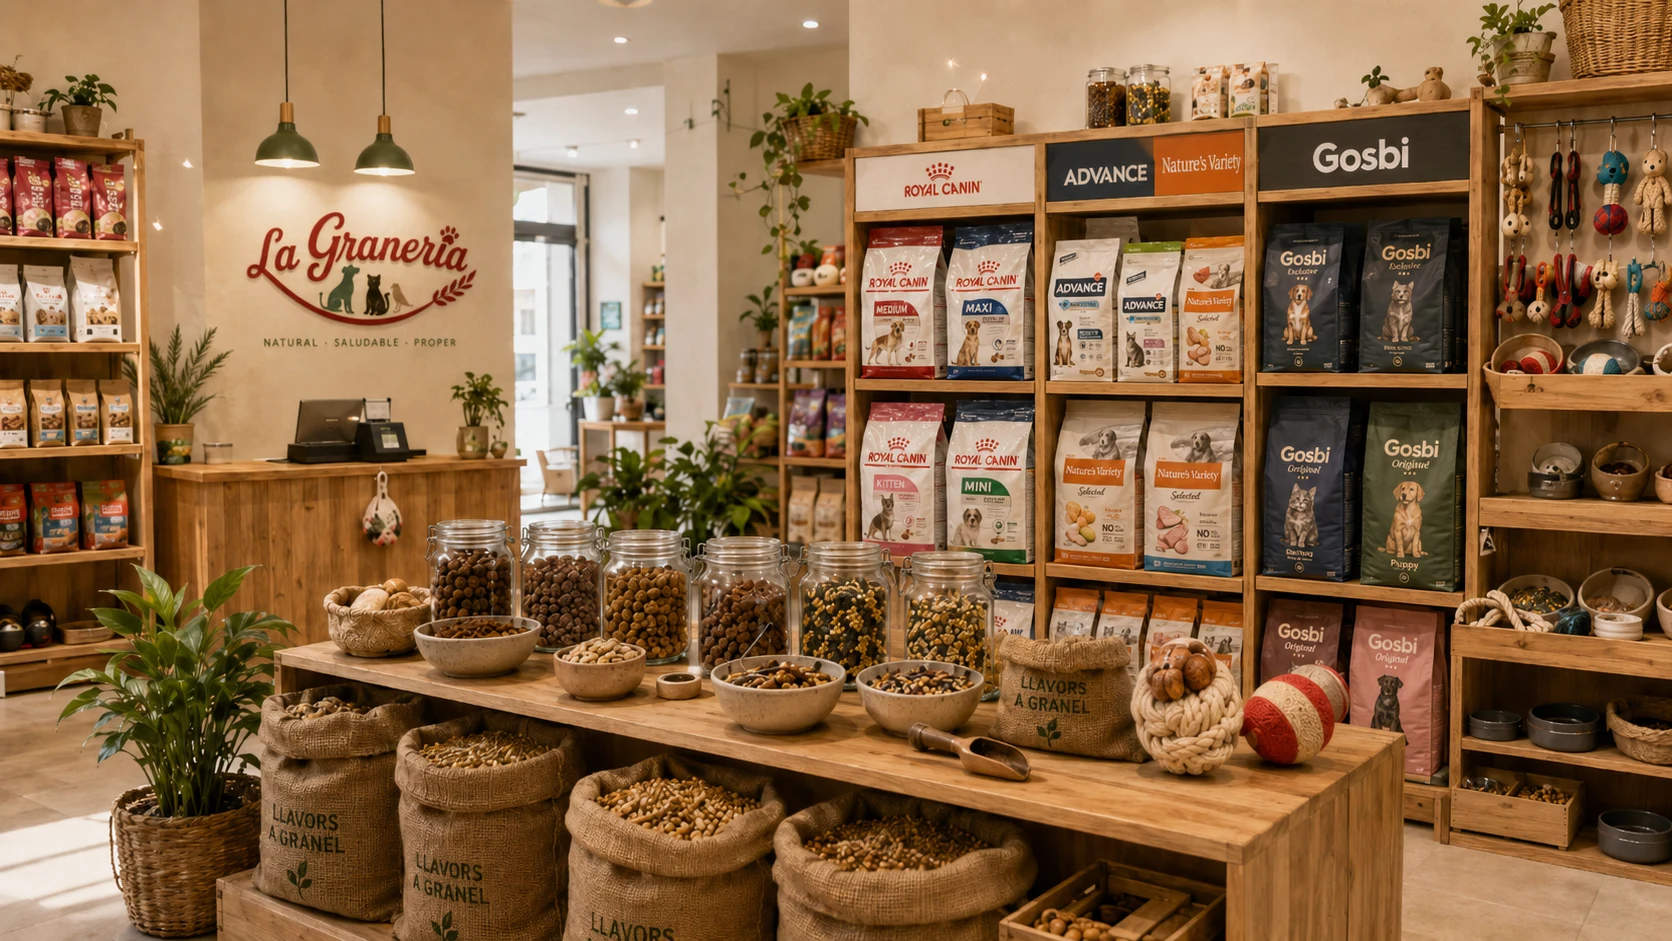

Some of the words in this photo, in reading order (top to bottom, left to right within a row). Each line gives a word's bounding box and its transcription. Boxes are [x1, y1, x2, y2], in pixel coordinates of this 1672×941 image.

[1161, 156, 1206, 174] Nature's
[1208, 153, 1241, 173] Variety
[1312, 136, 1409, 174] Gosbi
[1063, 164, 1148, 186] ADVANCE
[904, 180, 939, 197] ROYAL
[942, 180, 980, 195] CANIN
[247, 227, 300, 279] La
[1280, 249, 1327, 266] Gosbi
[1382, 243, 1431, 261] Gosbi
[869, 277, 897, 288] ROYAL
[899, 276, 928, 288] CANIN
[956, 275, 985, 287] ROYAL
[987, 274, 1017, 286] CANIN
[1055, 282, 1104, 294] ADVANCE
[876, 304, 908, 314] MEDIUM
[965, 302, 993, 313] MAXI
[1124, 300, 1164, 310] ADVANCE
[263, 338, 318, 347] NATURAL
[334, 338, 399, 347] SALUDABLE
[414, 338, 456, 347] PROPER
[1280, 445, 1331, 463] Gosbi
[1384, 438, 1440, 458] Gosbi
[868, 452, 895, 463] ROYAL
[897, 453, 927, 464] CANIN
[954, 454, 982, 466] ROYAL
[985, 455, 1018, 466] CANIN
[1065, 465, 1096, 476] Nature's
[1157, 468, 1190, 479] Nature's
[876, 478, 906, 489] KITTEN
[964, 481, 992, 492] MINI
[1170, 490, 1202, 501] Selected
[1102, 523, 1114, 532] NO
[1196, 529, 1210, 538] NO
[1390, 559, 1419, 571] Puppy
[1278, 623, 1325, 643] Gosbi
[1368, 633, 1418, 654] Gosbi
[1021, 676, 1087, 695] LLAVORS
[1014, 692, 1024, 707] A
[1027, 695, 1091, 714] GRANEL
[272, 803, 339, 831] LLAVORS
[268, 825, 277, 840] A
[279, 830, 345, 854] GRANEL
[416, 851, 483, 881] LLAVORS
[413, 875, 421, 890] A
[424, 880, 490, 905] GRANEL
[591, 911, 675, 941] LLAVORS
